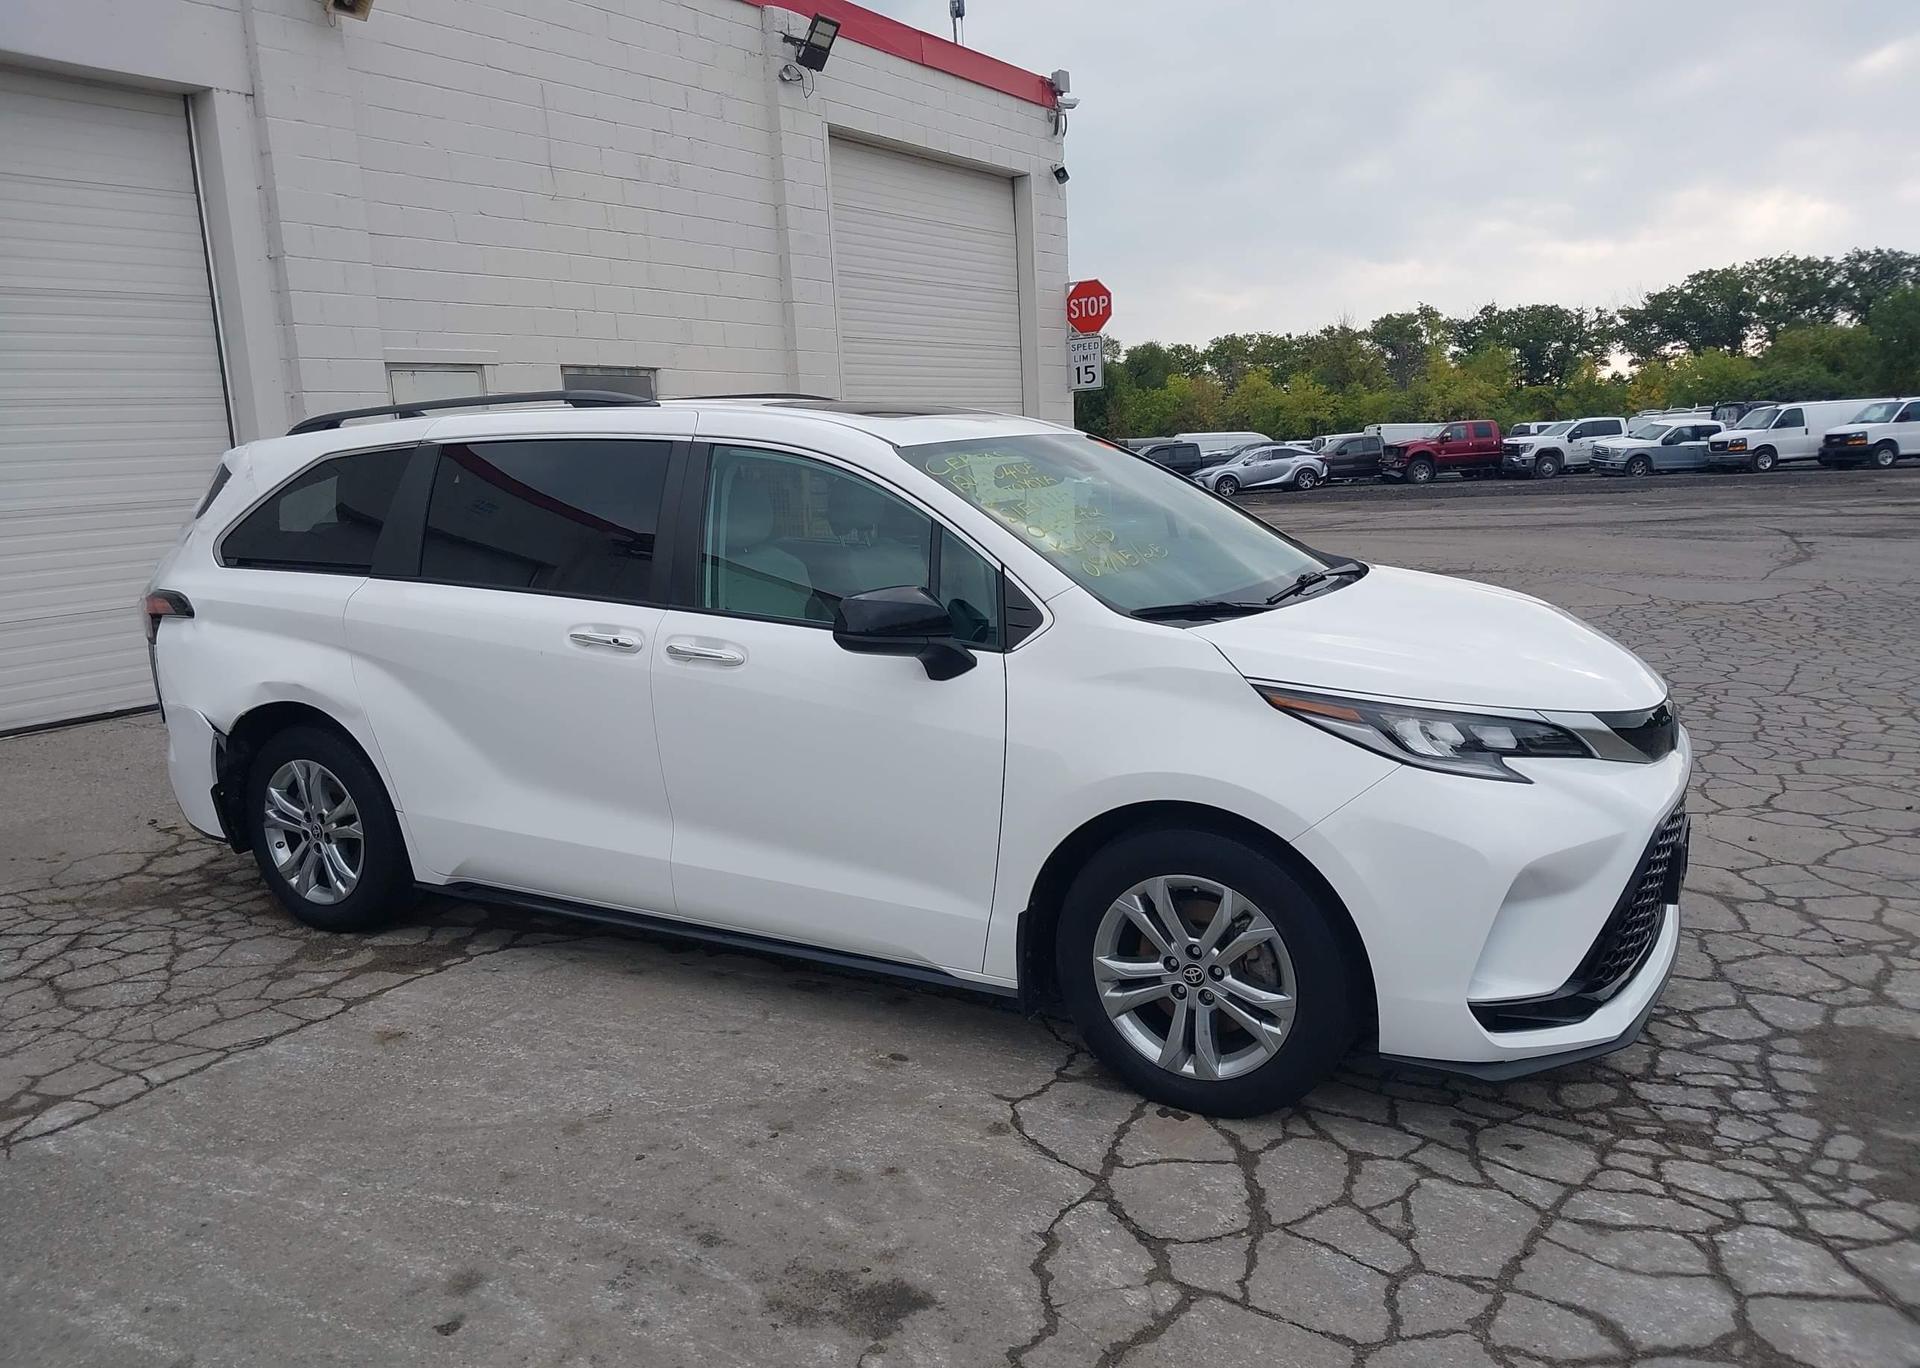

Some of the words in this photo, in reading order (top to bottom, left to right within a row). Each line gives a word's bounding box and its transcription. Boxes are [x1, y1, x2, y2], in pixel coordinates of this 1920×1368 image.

[1070, 295, 1108, 319] STOP
[1071, 342, 1099, 352] SPEED
[1074, 353, 1097, 363] LIMIT
[1075, 365, 1096, 385] 15
